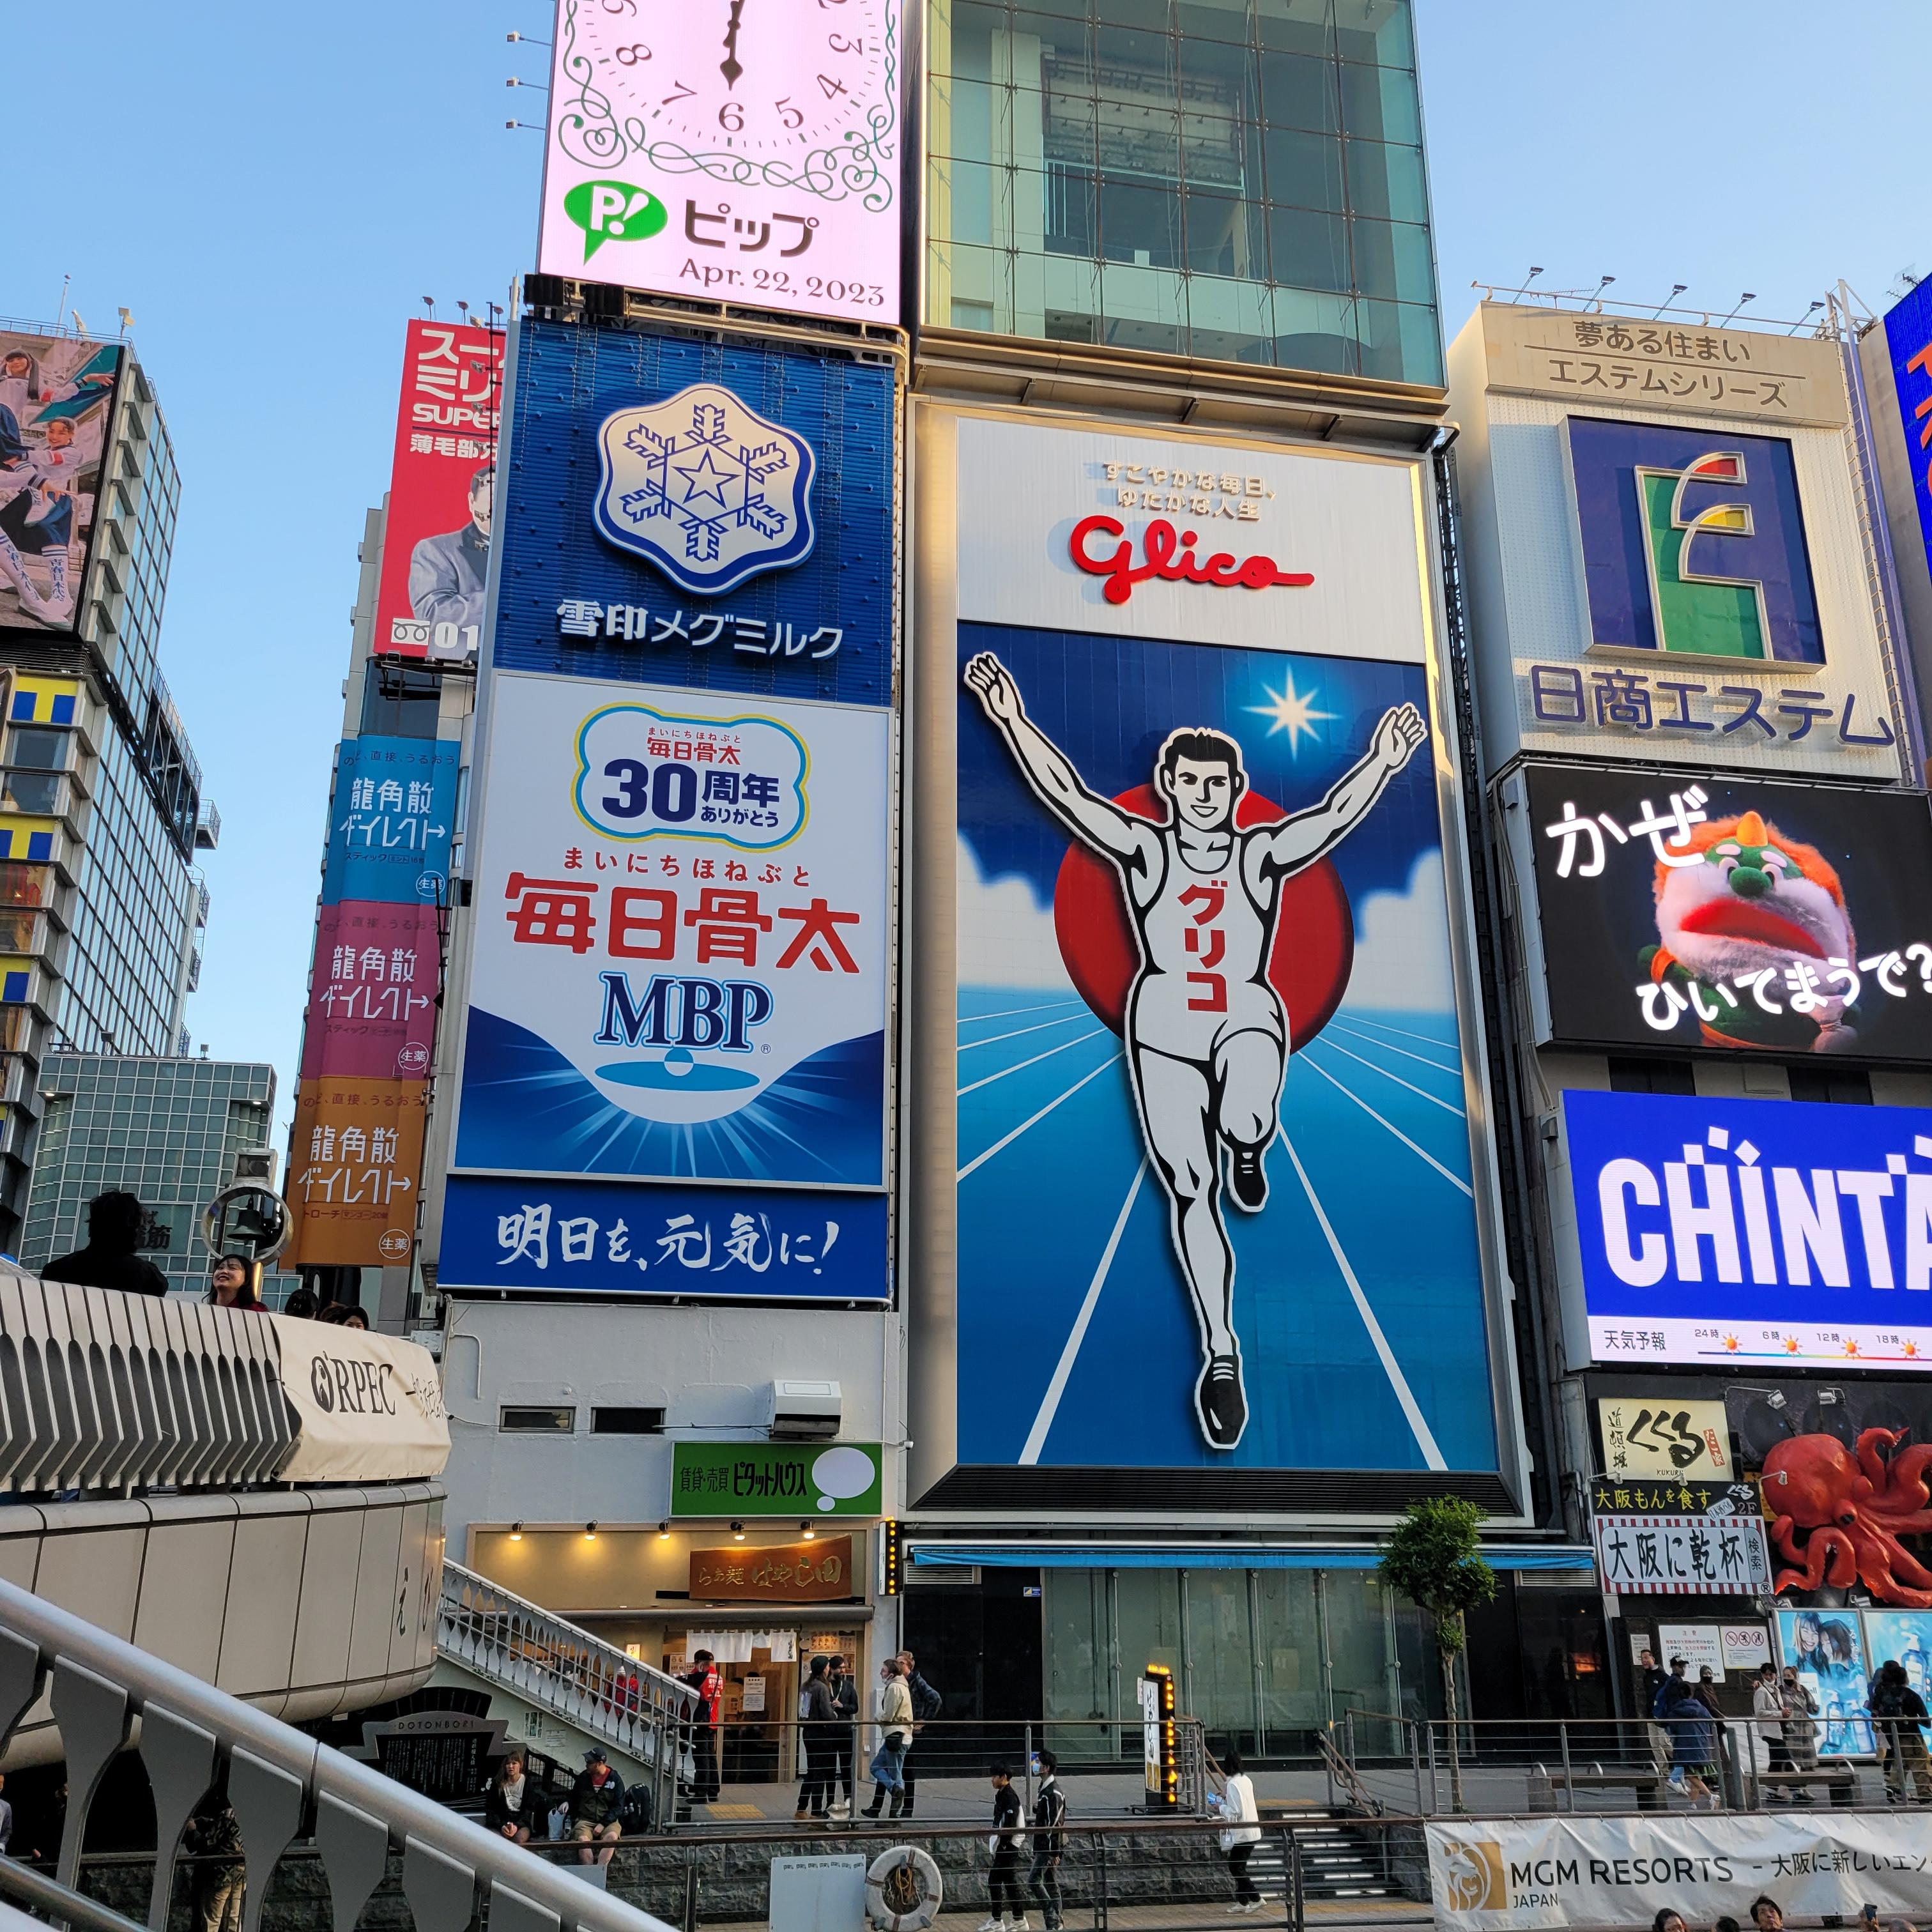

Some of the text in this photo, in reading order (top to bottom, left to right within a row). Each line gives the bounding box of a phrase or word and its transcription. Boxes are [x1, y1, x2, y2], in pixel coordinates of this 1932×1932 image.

[616, 43, 652, 66] 8
[829, 34, 863, 56] 3
[662, 80, 698, 105] 7
[816, 74, 848, 100] 4
[719, 103, 744, 132] 6
[775, 97, 804, 129] 5
[685, 199, 820, 257] ピップ
[679, 258, 885, 307] Apr. 22, 2023
[418, 328, 505, 368] スー
[1573, 321, 1751, 363] 夢ある住まい
[416, 364, 503, 402] ミリ
[1549, 360, 1788, 408] エステムシリーズ
[1103, 459, 1277, 500] すこやかな毎日、
[1117, 487, 1260, 521] ゆたかな人生
[556, 599, 843, 659] 雪印メグミルク
[1531, 664, 1896, 746] 日商エステム
[647, 737, 741, 765] 毎日骨太
[648, 726, 741, 744] まいにちほねぶと
[351, 777, 434, 815] 龍角散
[339, 815, 446, 850] ダイレクト
[700, 807, 779, 829] ありがとう
[1545, 784, 1709, 878] かぜ
[564, 847, 811, 888] まいにちほねぶと
[504, 871, 861, 974] 毎日骨太
[332, 945, 418, 983] 龍角散
[1177, 879, 1229, 1013] グリコ
[319, 985, 429, 1021] ダイレクト
[593, 970, 774, 1055] MBP
[310, 1124, 399, 1164] 龍角散
[297, 1167, 411, 1204] ダイレクト
[381, 1238, 408, 1250] 生薬
[1604, 1330, 1666, 1352] 天気予報
[1607, 1407, 1628, 1469] 道頓堀
[1626, 1409, 1705, 1469] くくる
[680, 1462, 808, 1496] 賃貸・売買 ピタットハウス
[1595, 1487, 1712, 1510] 大阪もんを食す
[1737, 1502, 1757, 1515] 2F
[1608, 1529, 1744, 1581] 大阪に乾杯
[1748, 1537, 1762, 1571] 検索
[399, 1721, 474, 1729] DOTONBORI
[1510, 1859, 1579, 1888] MGM
[1590, 1857, 1733, 1885] RESORTS
[1770, 1850, 1932, 1878] 大阪に新しいエン
[1514, 1892, 1558, 1909] JAPAN
